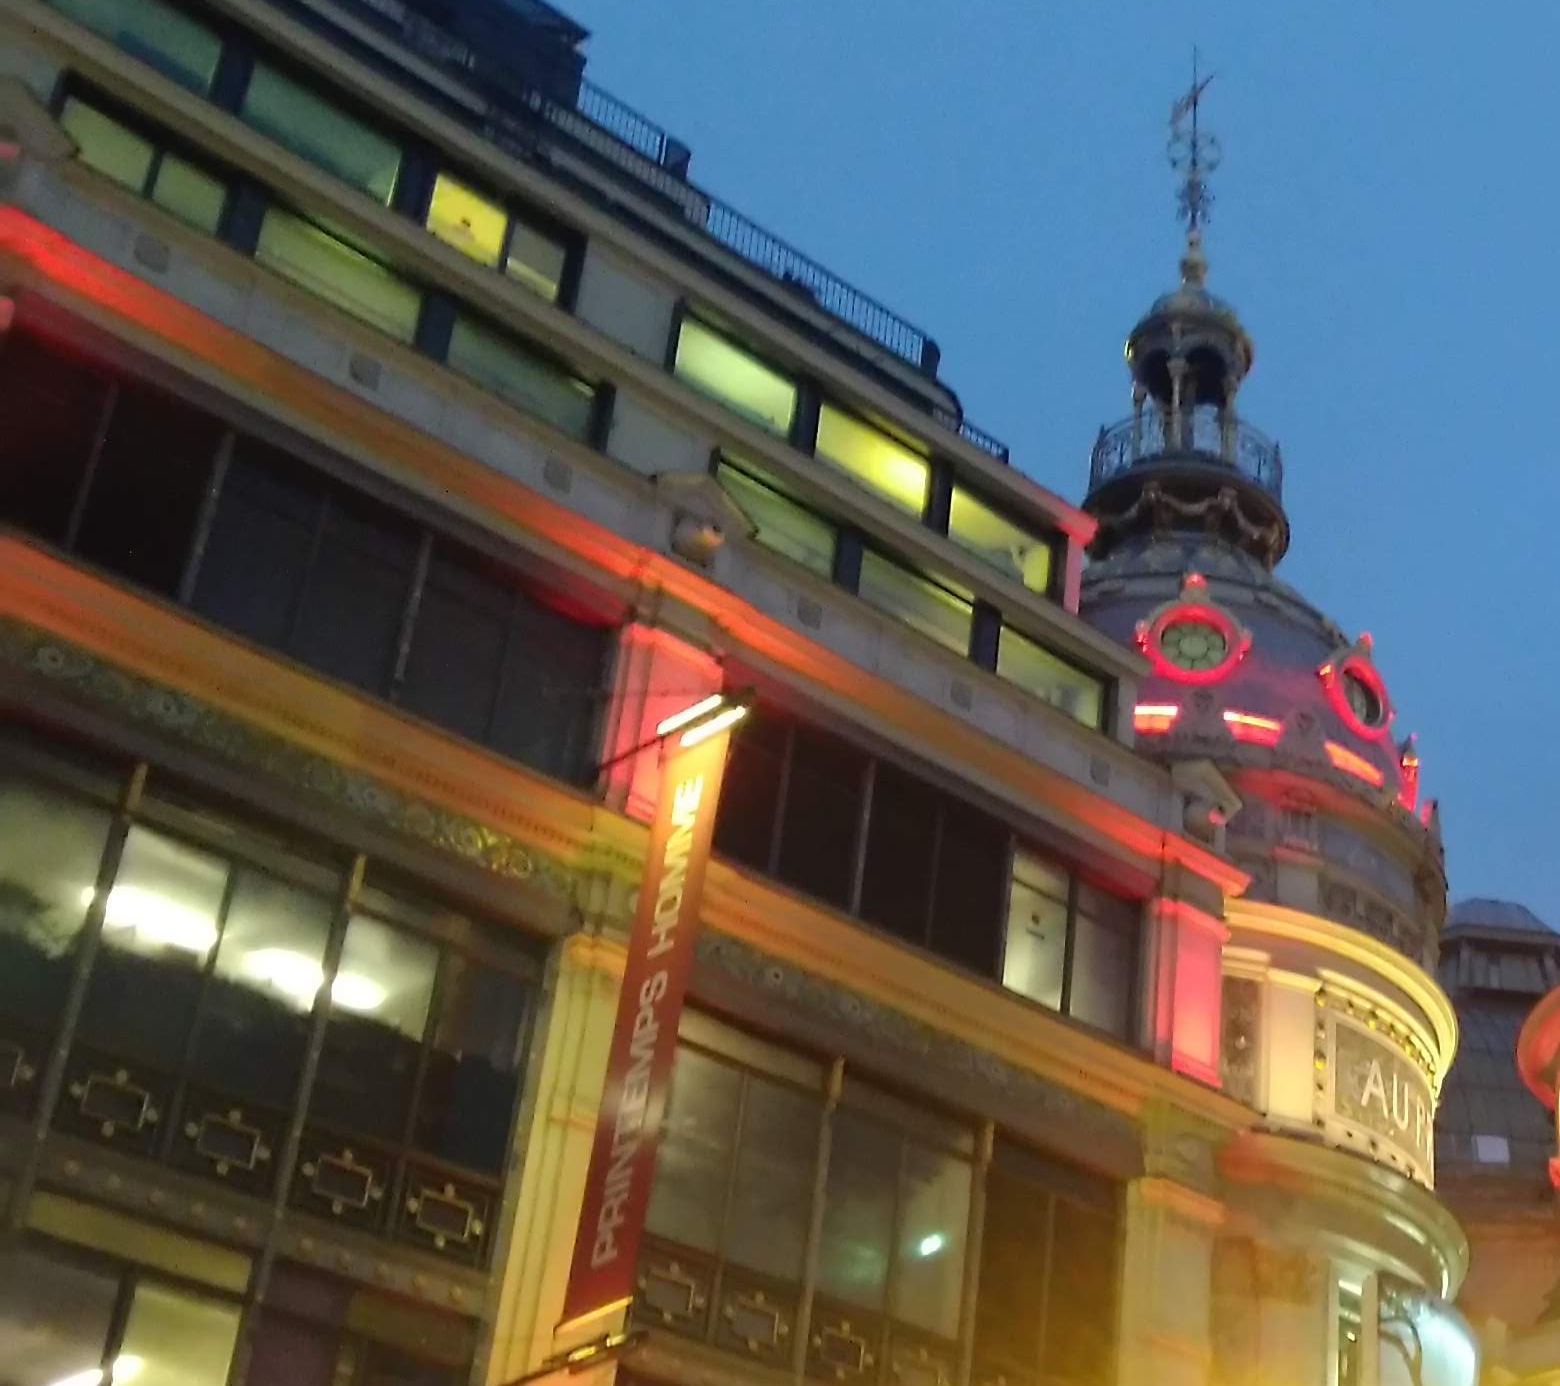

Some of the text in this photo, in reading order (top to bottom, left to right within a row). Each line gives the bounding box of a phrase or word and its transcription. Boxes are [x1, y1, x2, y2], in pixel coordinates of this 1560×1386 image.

[591, 771, 704, 1271] PRINTEMPS HOMME
[1360, 1059, 1409, 1131] AU
